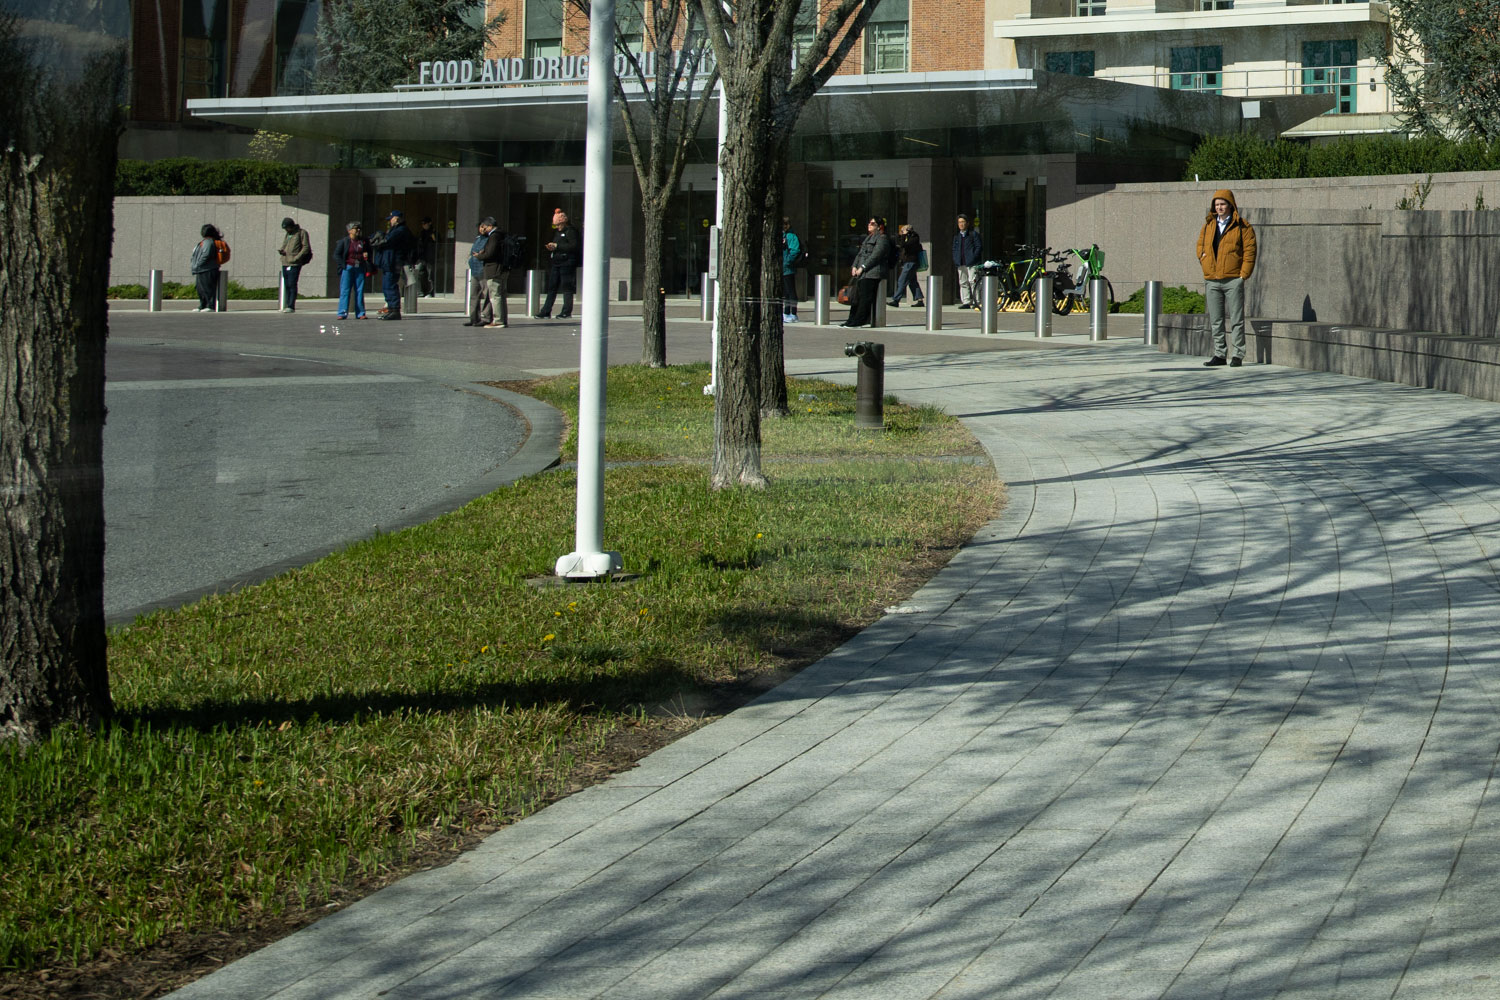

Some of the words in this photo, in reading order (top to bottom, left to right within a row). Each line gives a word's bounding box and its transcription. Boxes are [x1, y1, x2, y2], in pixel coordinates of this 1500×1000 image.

[419, 60, 474, 85] FOOD
[481, 57, 524, 82] AND
[533, 54, 589, 80] DRUG
